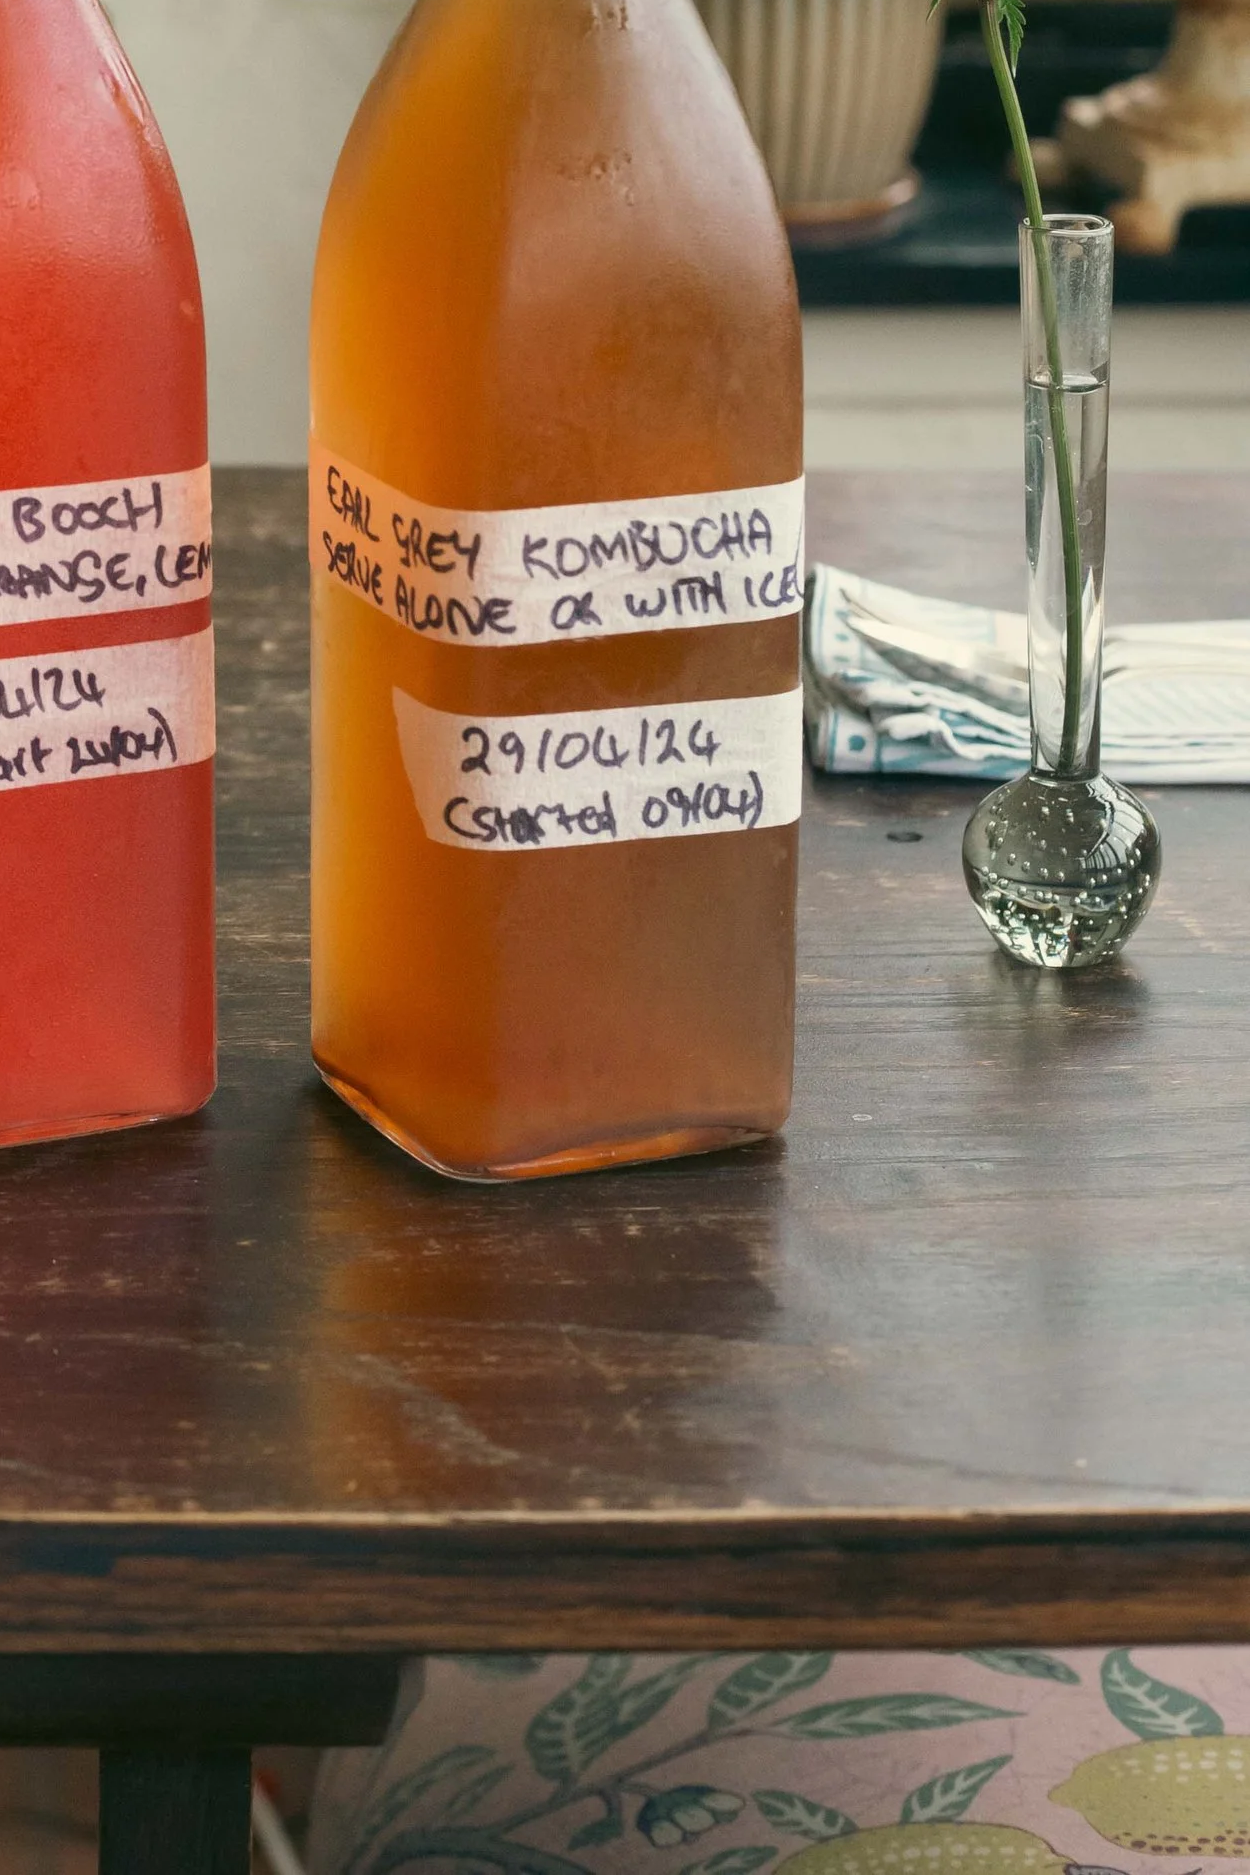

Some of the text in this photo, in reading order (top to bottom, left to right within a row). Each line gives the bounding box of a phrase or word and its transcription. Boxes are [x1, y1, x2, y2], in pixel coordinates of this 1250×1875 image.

[12, 482, 163, 543] BOOCH
[327, 464, 772, 580] EARL GREY KOMBUCHA
[323, 530, 383, 605] SERVE
[395, 577, 518, 634] ALONE
[551, 596, 603, 630] OR
[626, 571, 727, 616] WITH
[461, 718, 722, 774] 29/04/24
